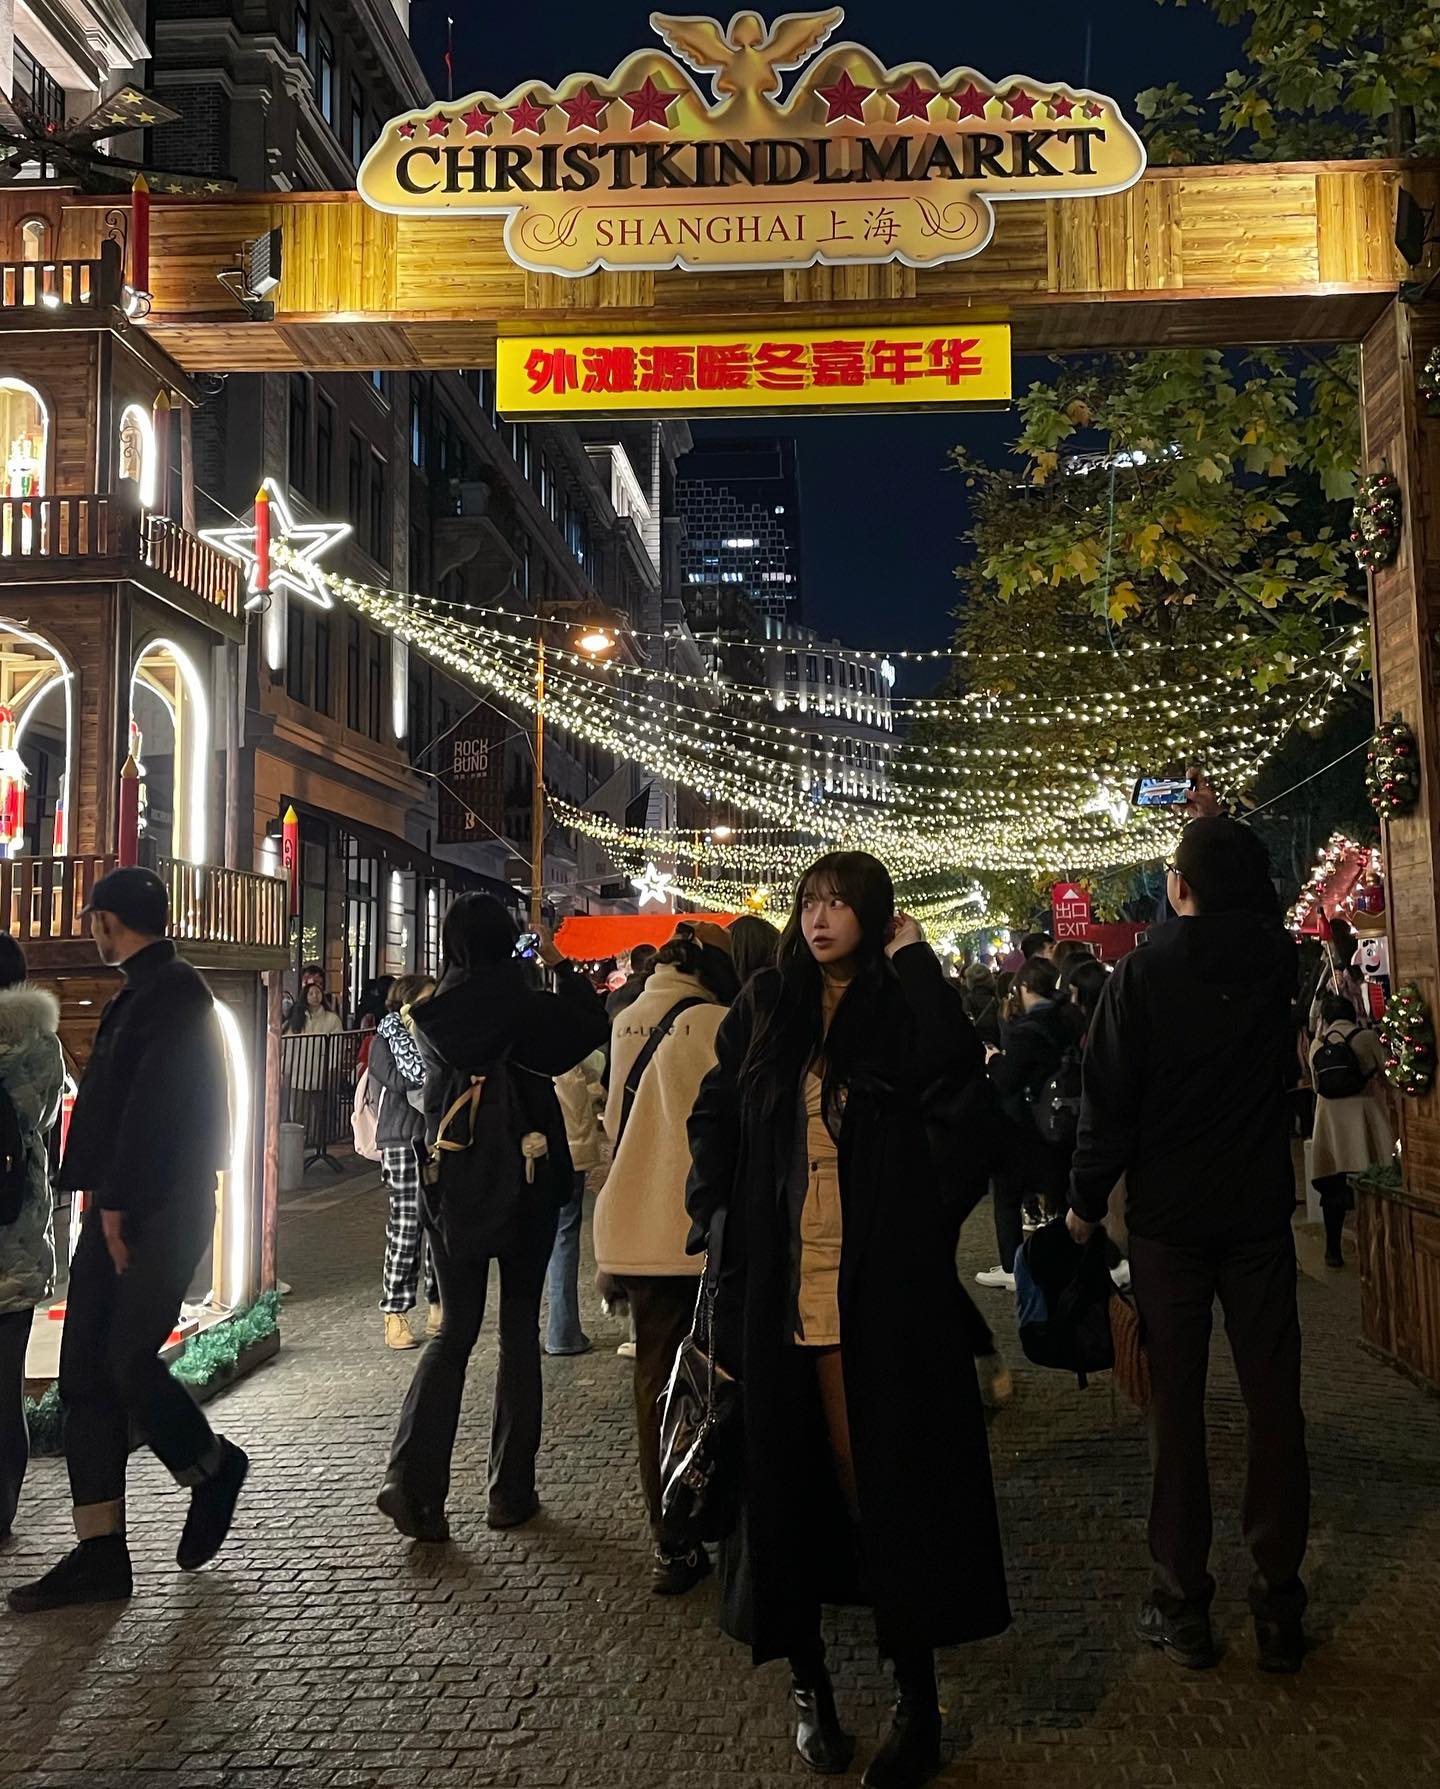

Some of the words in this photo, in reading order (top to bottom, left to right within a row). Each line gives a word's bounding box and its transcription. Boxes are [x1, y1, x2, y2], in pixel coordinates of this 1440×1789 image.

[396, 127, 1106, 195] CHRISTKINDLMARKT
[596, 213, 806, 247] SHANGHAI
[815, 206, 902, 245] 上海
[523, 338, 983, 394] 外滩源暖冬嘉年华
[454, 738, 489, 757] ROCK
[453, 754, 488, 773] BUND
[1055, 902, 1087, 920] 出口
[1057, 921, 1089, 937] EXIT
